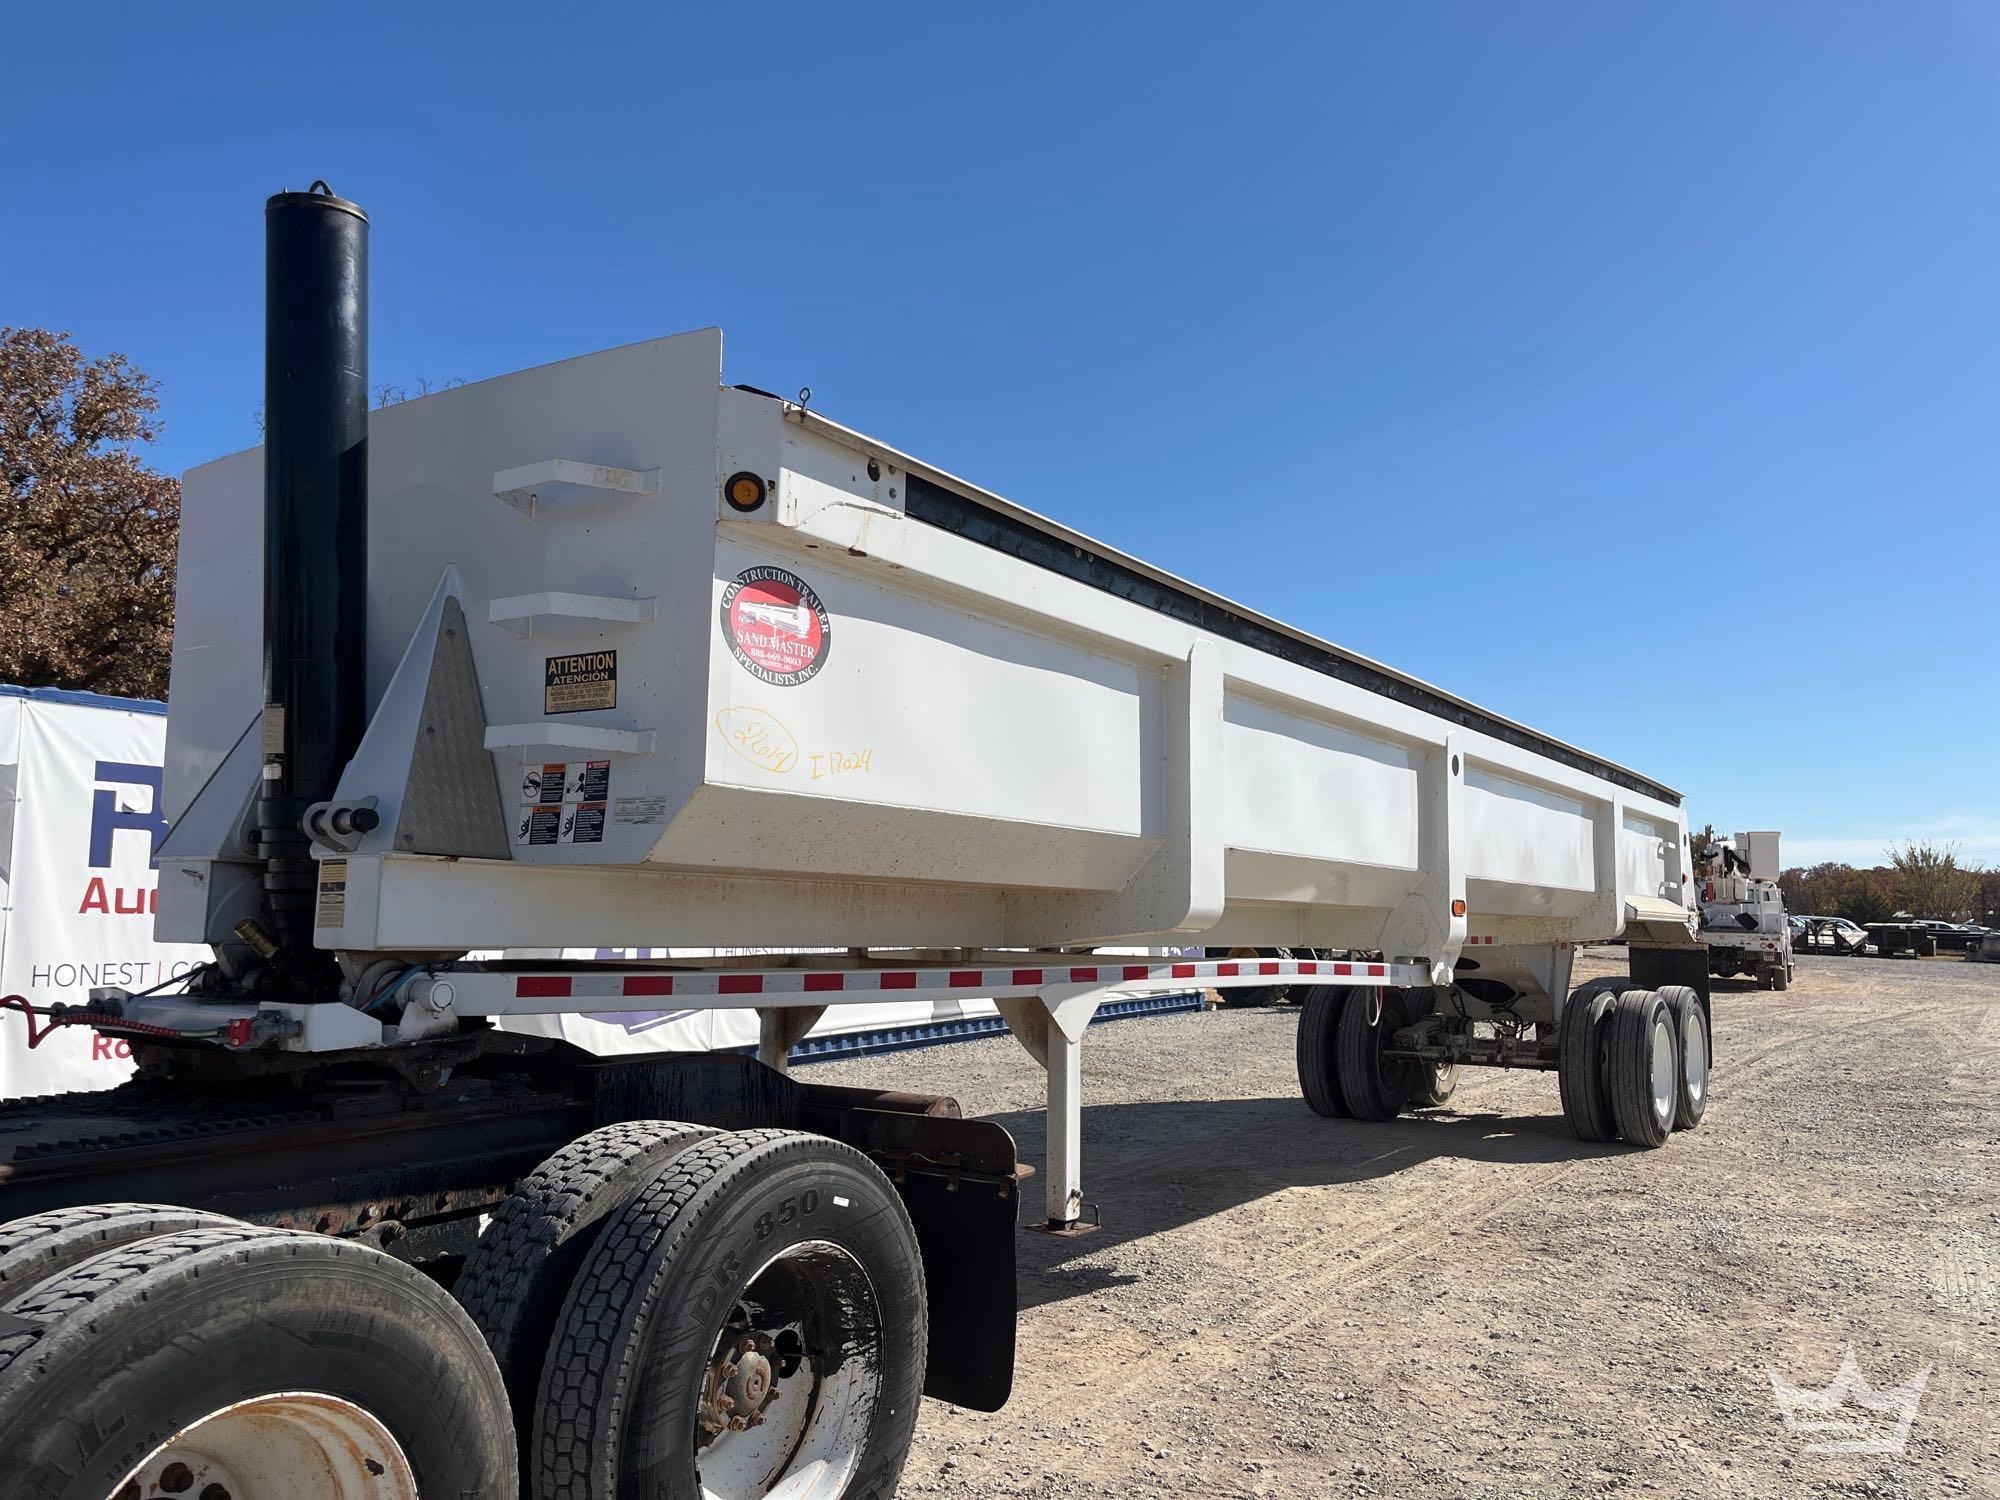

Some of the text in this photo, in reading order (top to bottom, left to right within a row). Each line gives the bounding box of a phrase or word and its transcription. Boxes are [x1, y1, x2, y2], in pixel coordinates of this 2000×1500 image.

[721, 568, 830, 634] CONSTRUCTION TRAILER
[736, 628, 815, 660] SAND MASTER
[750, 647, 802, 667] 888-669-0003
[548, 653, 614, 676] ATTENTION
[552, 670, 609, 686] ATENCIÓN
[733, 647, 819, 686] SPECIALISTS, INC.
[31, 962, 151, 988] HONEST
[690, 1188, 821, 1327] DR-850
